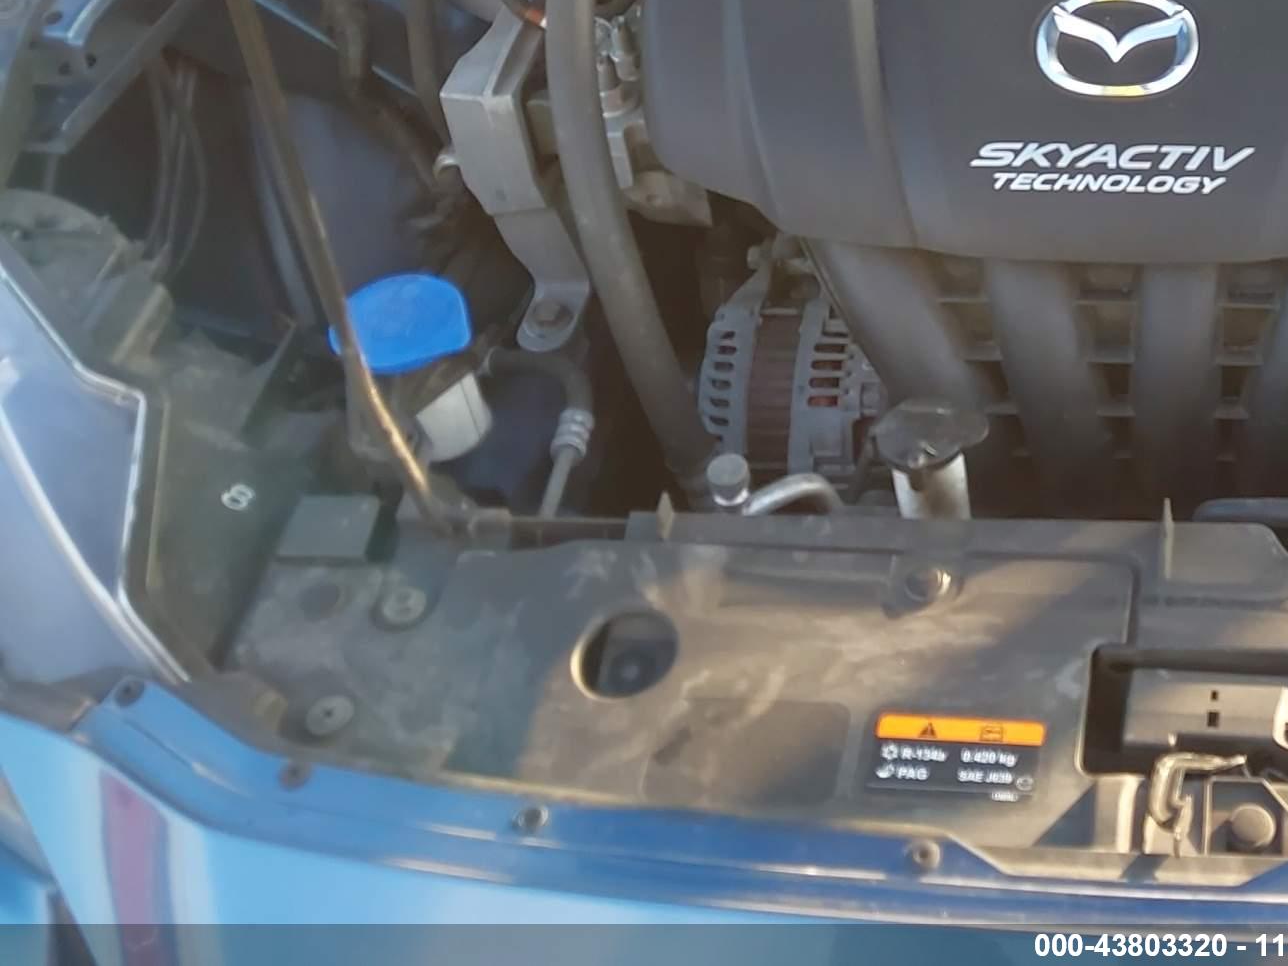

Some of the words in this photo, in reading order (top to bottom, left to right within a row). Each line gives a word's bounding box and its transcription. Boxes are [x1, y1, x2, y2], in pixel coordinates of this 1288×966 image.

[970, 141, 1256, 172] SKYACTIV
[993, 172, 1227, 195] TECHNOLOGY
[897, 766, 929, 781] PAG
